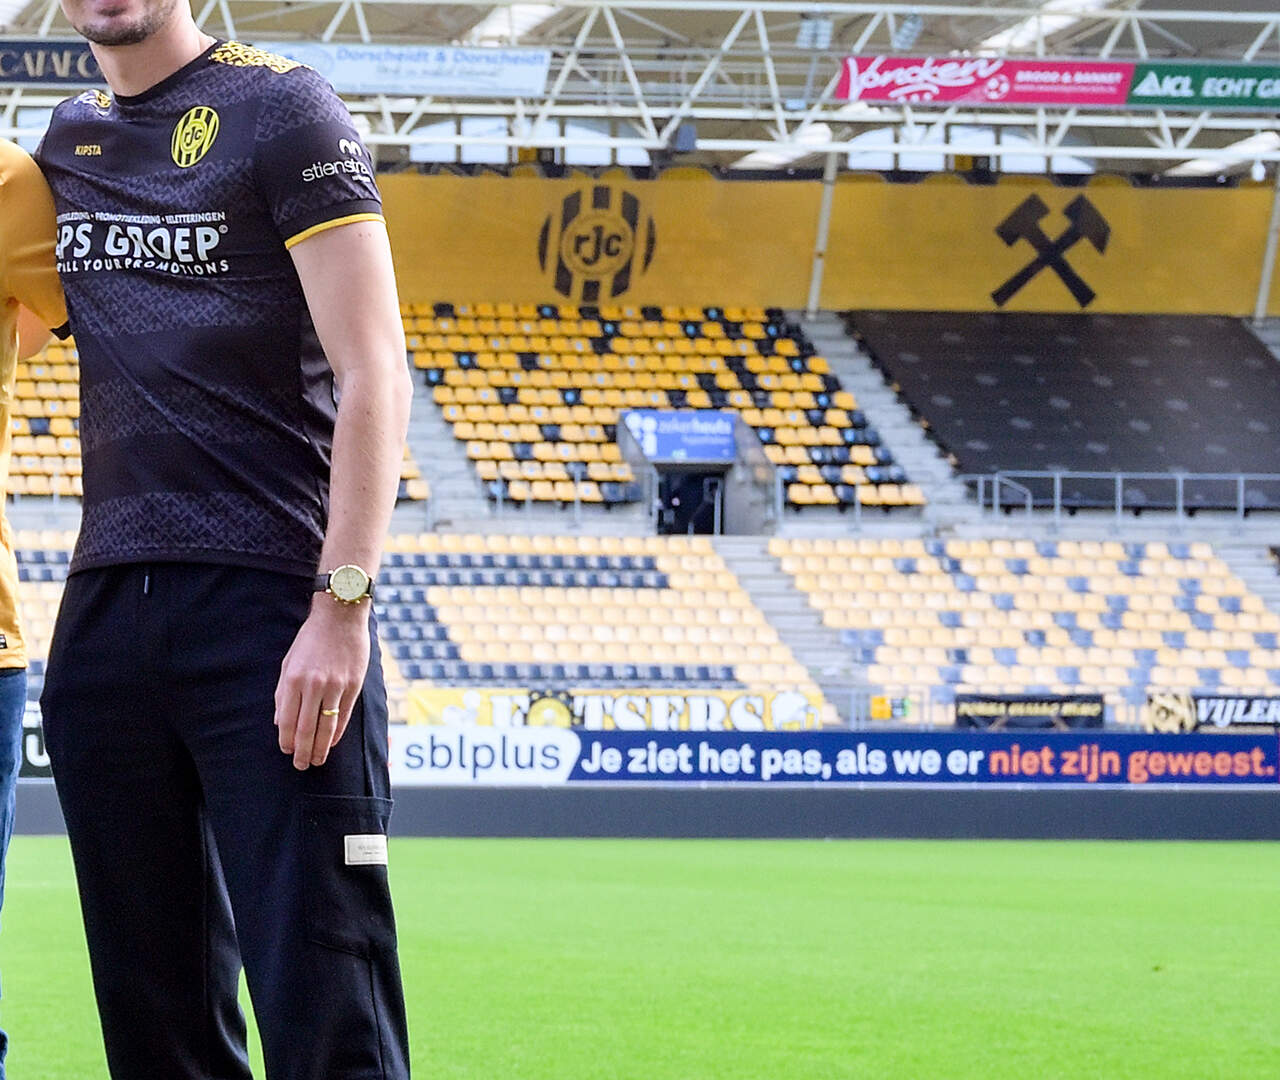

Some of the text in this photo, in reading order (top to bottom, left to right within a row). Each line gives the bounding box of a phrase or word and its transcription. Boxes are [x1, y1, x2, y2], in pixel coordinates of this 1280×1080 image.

[75, 145, 102, 156] KIPSTA
[302, 158, 370, 182] stienstra
[105, 224, 219, 262] GROEP
[83, 258, 123, 272] YOUR
[124, 258, 230, 276] PROMOTIONS
[404, 734, 561, 779] sblplus
[580, 741, 1275, 783] Je ziet het pas, als we er niet zijn geweest.
